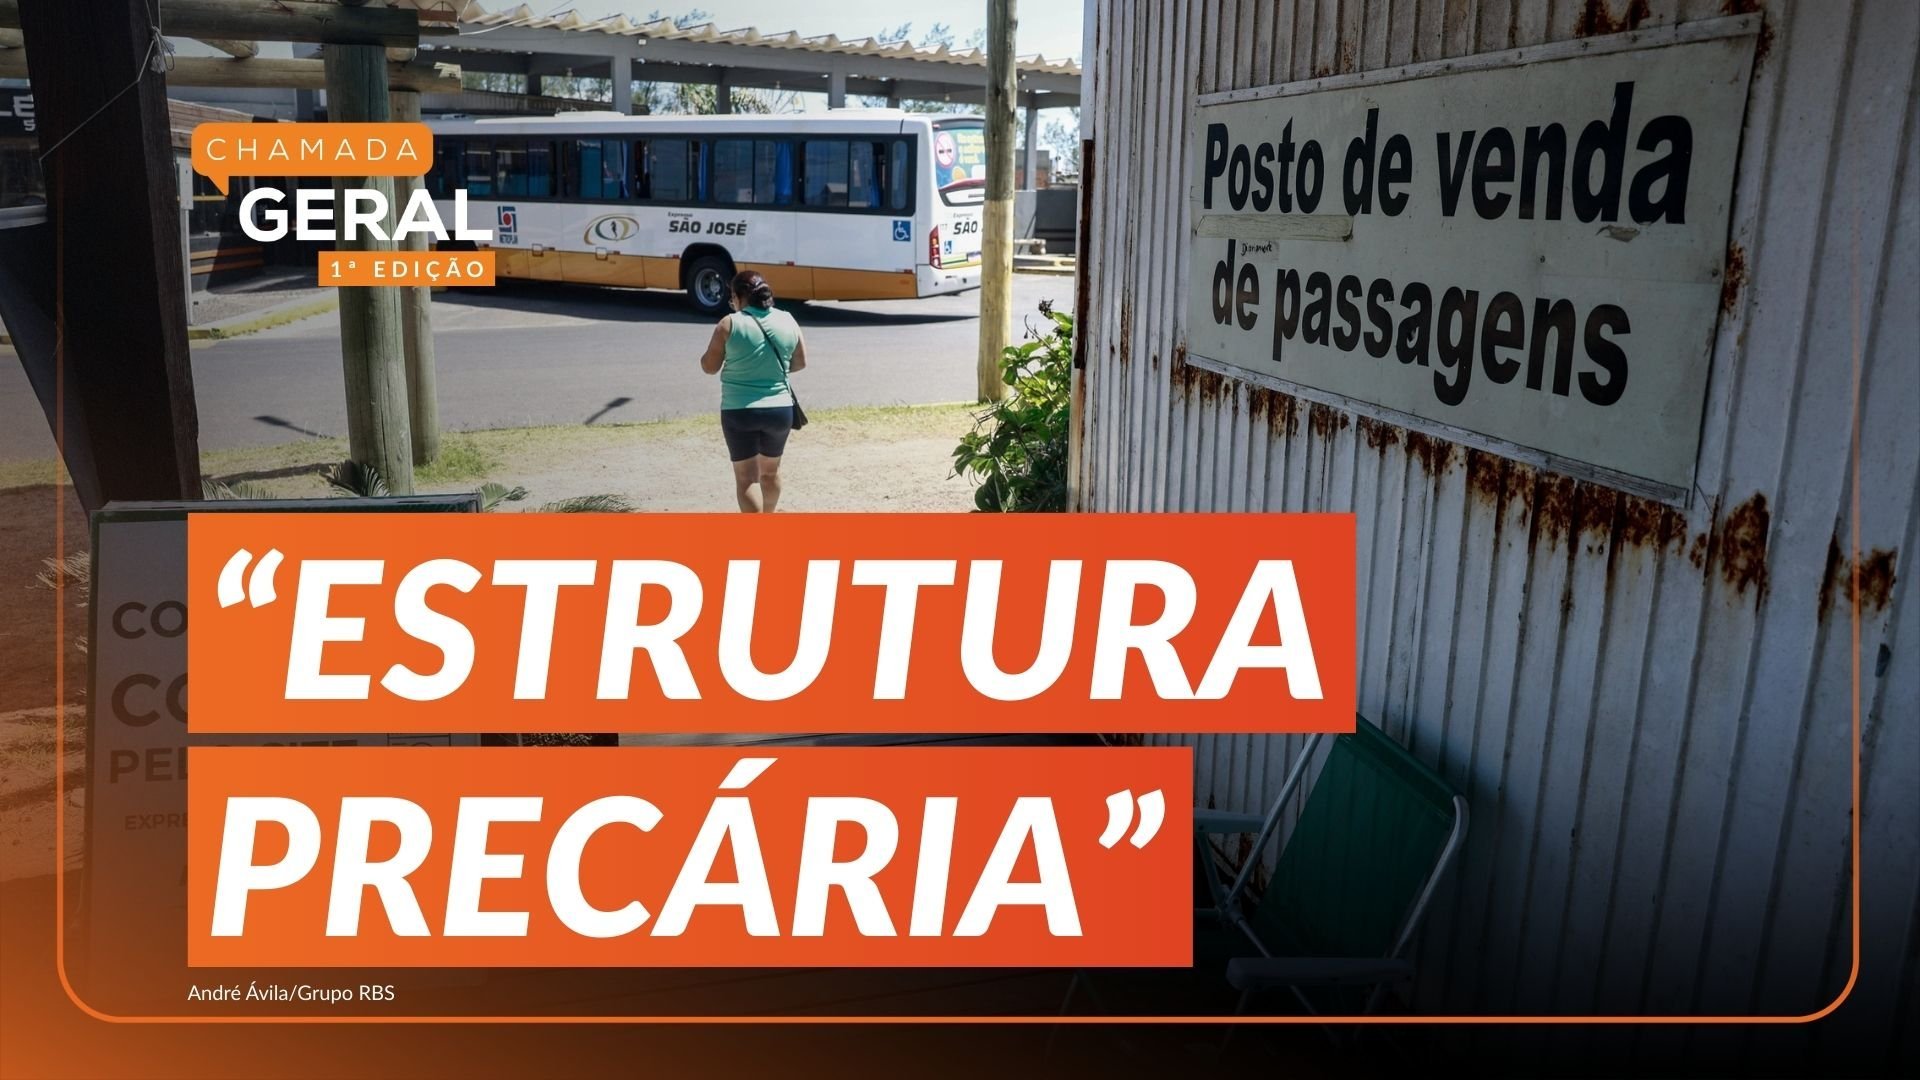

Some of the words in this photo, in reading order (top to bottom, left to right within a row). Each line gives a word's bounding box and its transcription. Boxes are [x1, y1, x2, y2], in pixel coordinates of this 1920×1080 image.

[1203, 116, 1325, 214] Posto
[1342, 107, 1413, 217] de
[1436, 80, 1693, 225] venda
[668, 217, 702, 234] SÃO
[706, 219, 747, 236] JOSÉ
[1212, 238, 1260, 331] de
[1272, 267, 1632, 407] passagens
